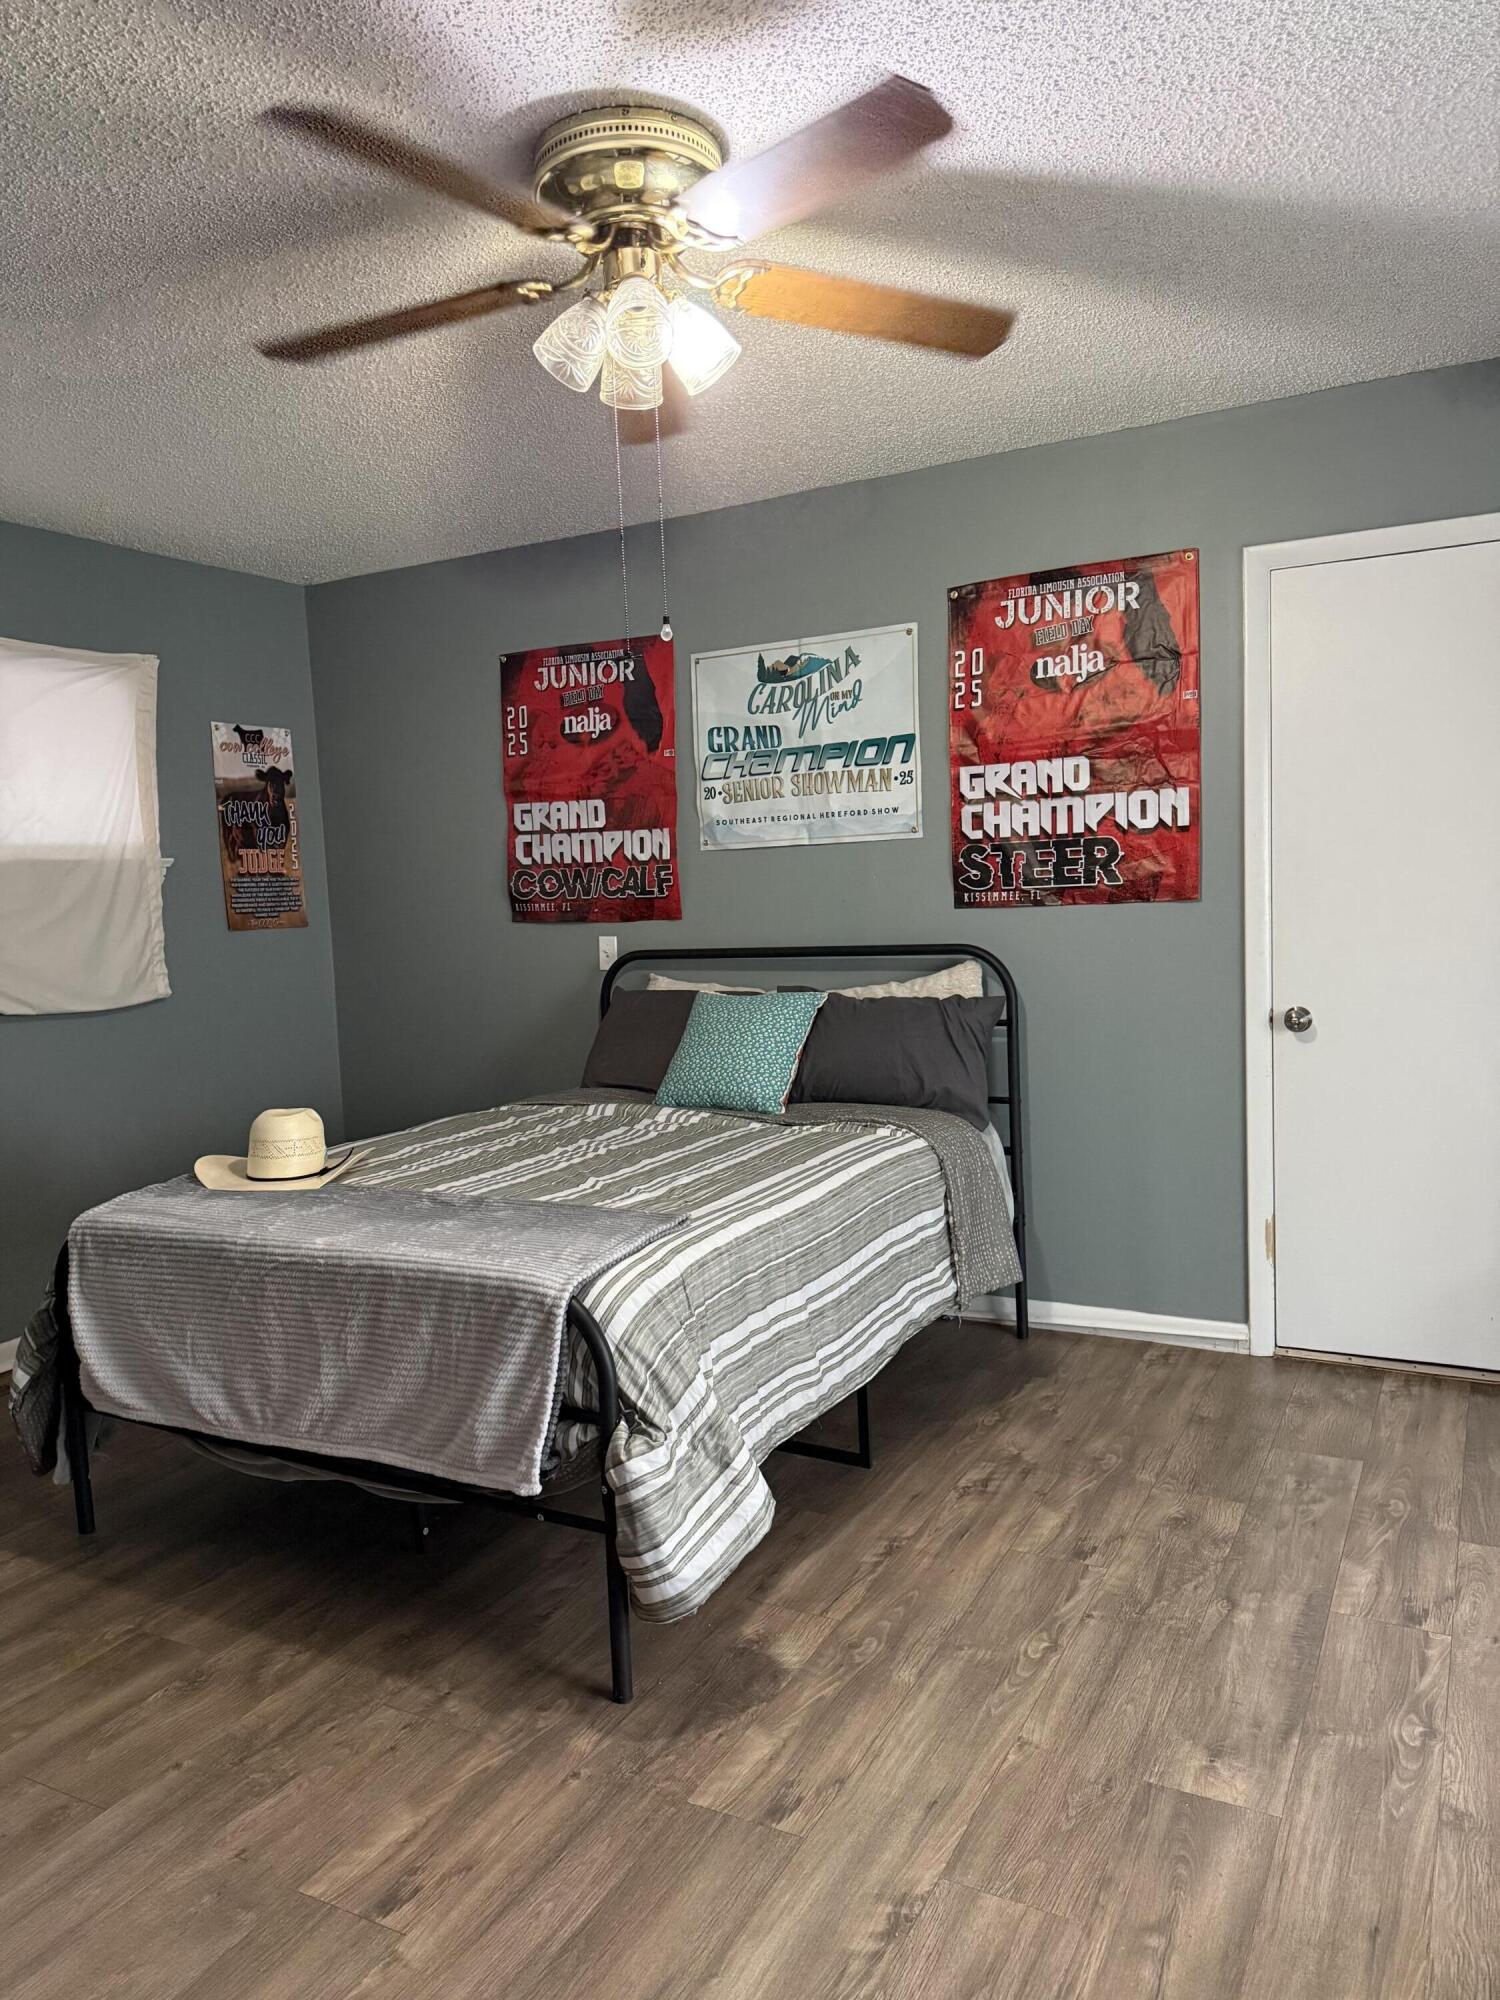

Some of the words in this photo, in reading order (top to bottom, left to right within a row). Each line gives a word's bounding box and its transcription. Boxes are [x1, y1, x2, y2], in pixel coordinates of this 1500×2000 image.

[1008, 585, 1037, 599] FLORIDA
[1040, 580, 1075, 594] LIMOUSIN
[1077, 571, 1125, 588] ASSOCIATION
[994, 581, 1141, 629] JUNIOR
[1071, 615, 1094, 637] DAY
[591, 649, 624, 661] ASSOCIATION
[954, 647, 984, 678] 20
[1035, 644, 1106, 682] nalja
[534, 659, 635, 691] JUNIOR
[747, 645, 862, 715] CAROLINA
[792, 679, 863, 739] Mind
[954, 681, 983, 710] 25
[506, 705, 528, 730] 20
[563, 706, 612, 739] nalja
[507, 732, 528, 756] 25
[707, 724, 783, 753] GRAND
[242, 752, 268, 765] CLASSIC
[722, 776, 785, 804] SENIOR
[791, 768, 892, 797] SHOWMAN
[959, 756, 1090, 800] GRAND
[222, 800, 272, 827] THANK
[513, 799, 607, 833] GRAND
[716, 816, 767, 826] SOUTHEAST
[771, 813, 816, 822] REGIONAL
[819, 809, 868, 819] HEREFORD
[872, 806, 900, 815] SHOW
[960, 786, 1190, 840] CHAMPION
[288, 803, 299, 870] 2025
[514, 827, 671, 865] CHAMPION
[238, 848, 285, 874] JUDGE
[958, 836, 1124, 890] STEER
[510, 864, 673, 900] COW/CALF
[1031, 890, 1041, 900] FL
